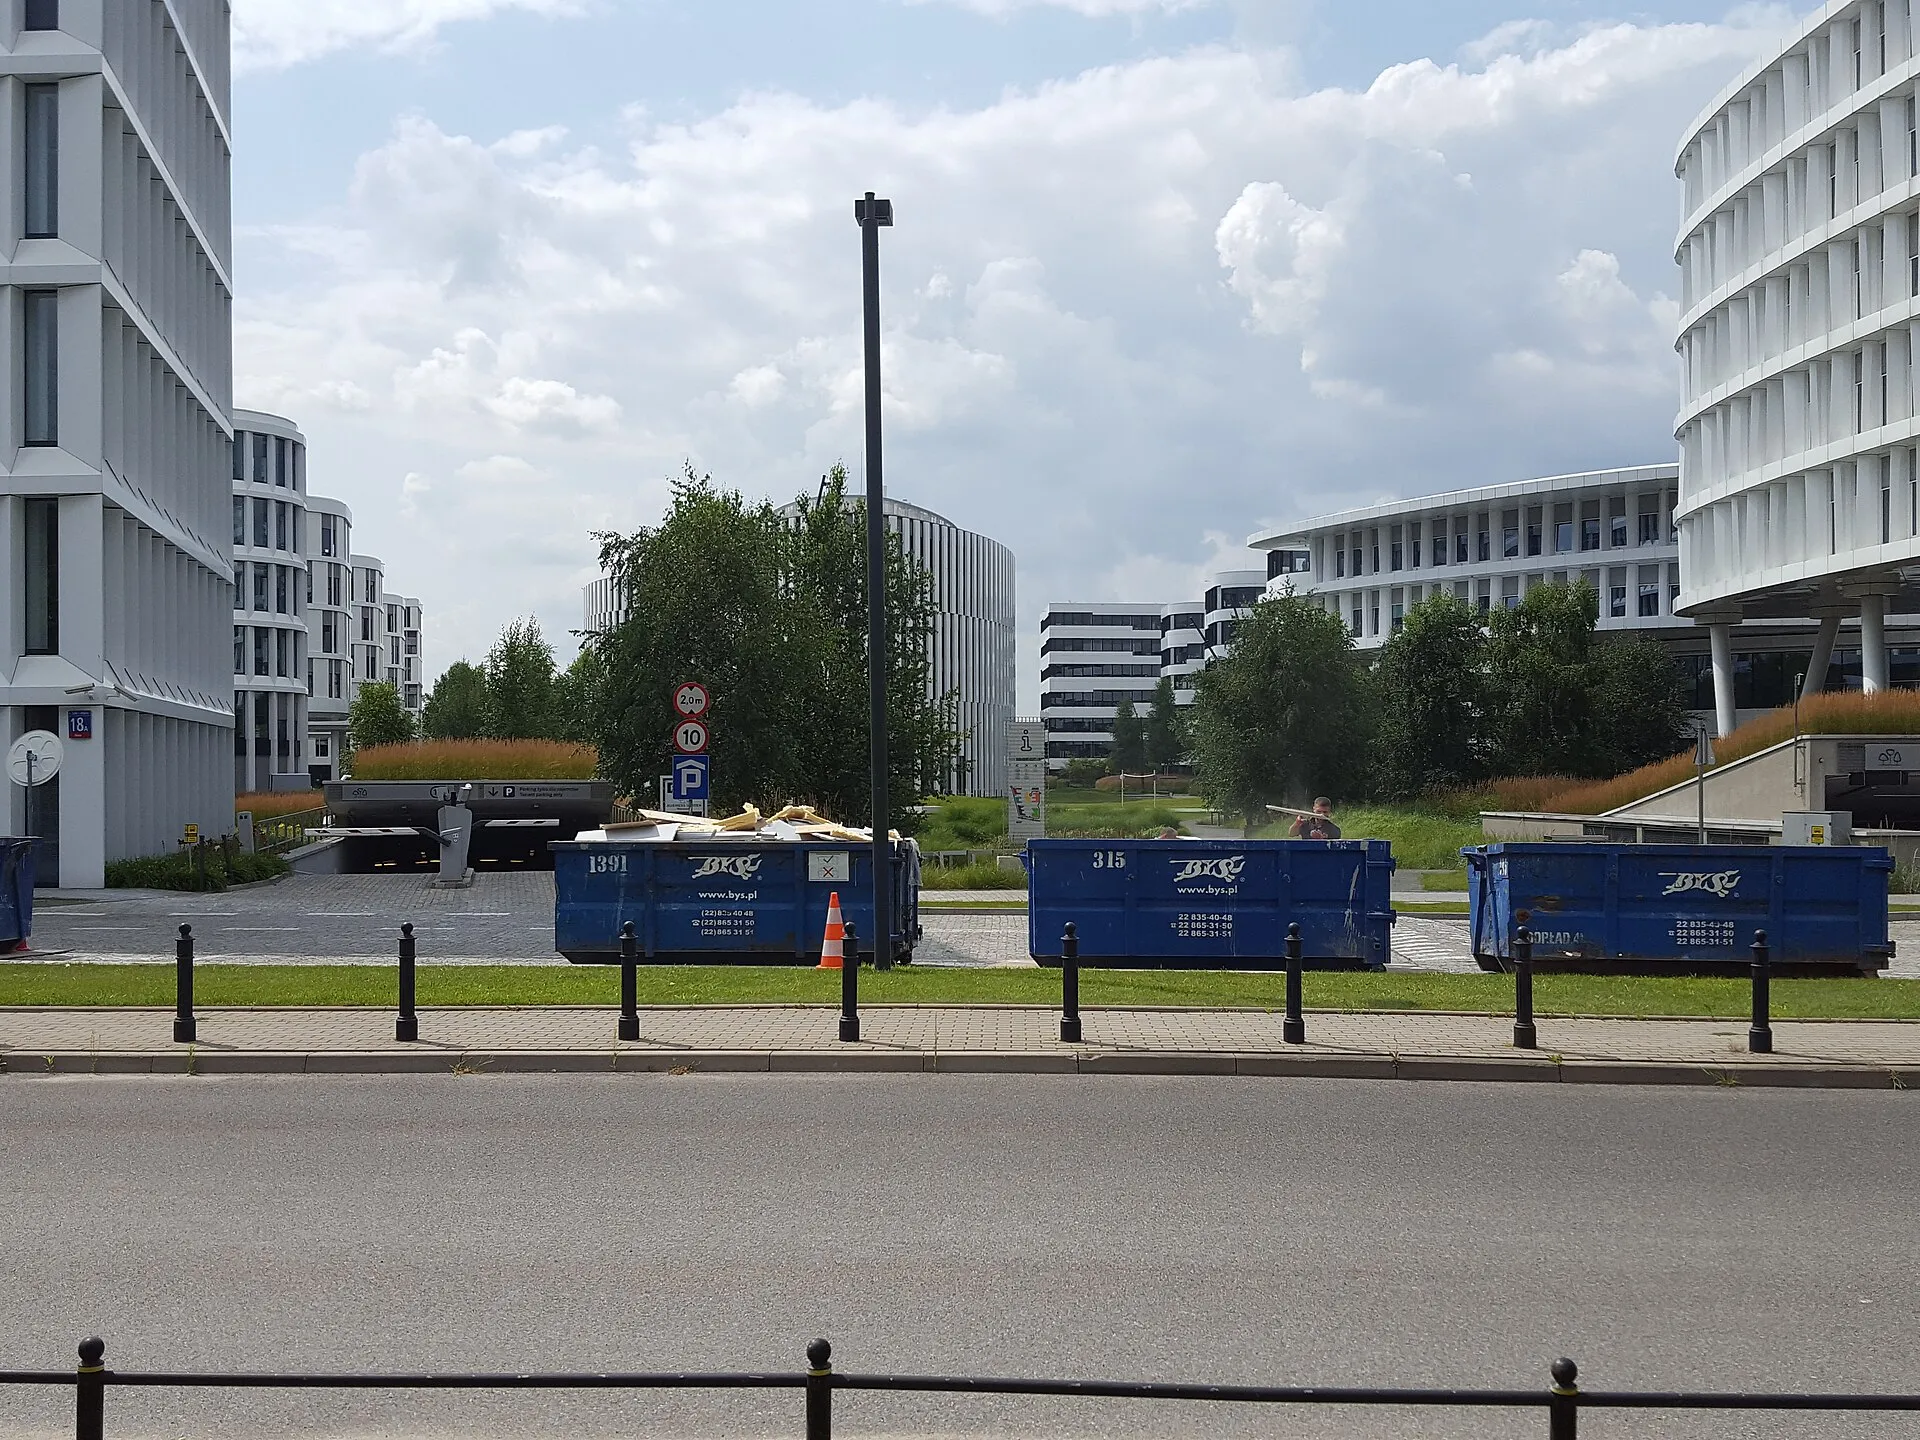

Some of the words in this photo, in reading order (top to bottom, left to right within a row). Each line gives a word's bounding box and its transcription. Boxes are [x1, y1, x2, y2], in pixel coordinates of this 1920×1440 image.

[682, 729, 701, 746] 10
[1020, 729, 1033, 752] i
[681, 768, 702, 796] P
[506, 788, 513, 796] P
[589, 854, 628, 873] 1391
[1092, 851, 1126, 869] 315
[698, 890, 758, 901] www.bys.pl
[1177, 884, 1238, 896] www.bys.pl
[1178, 913, 1189, 921] 22
[1676, 929, 1688, 937] 22
[1690, 929, 1735, 937] 865-31-50
